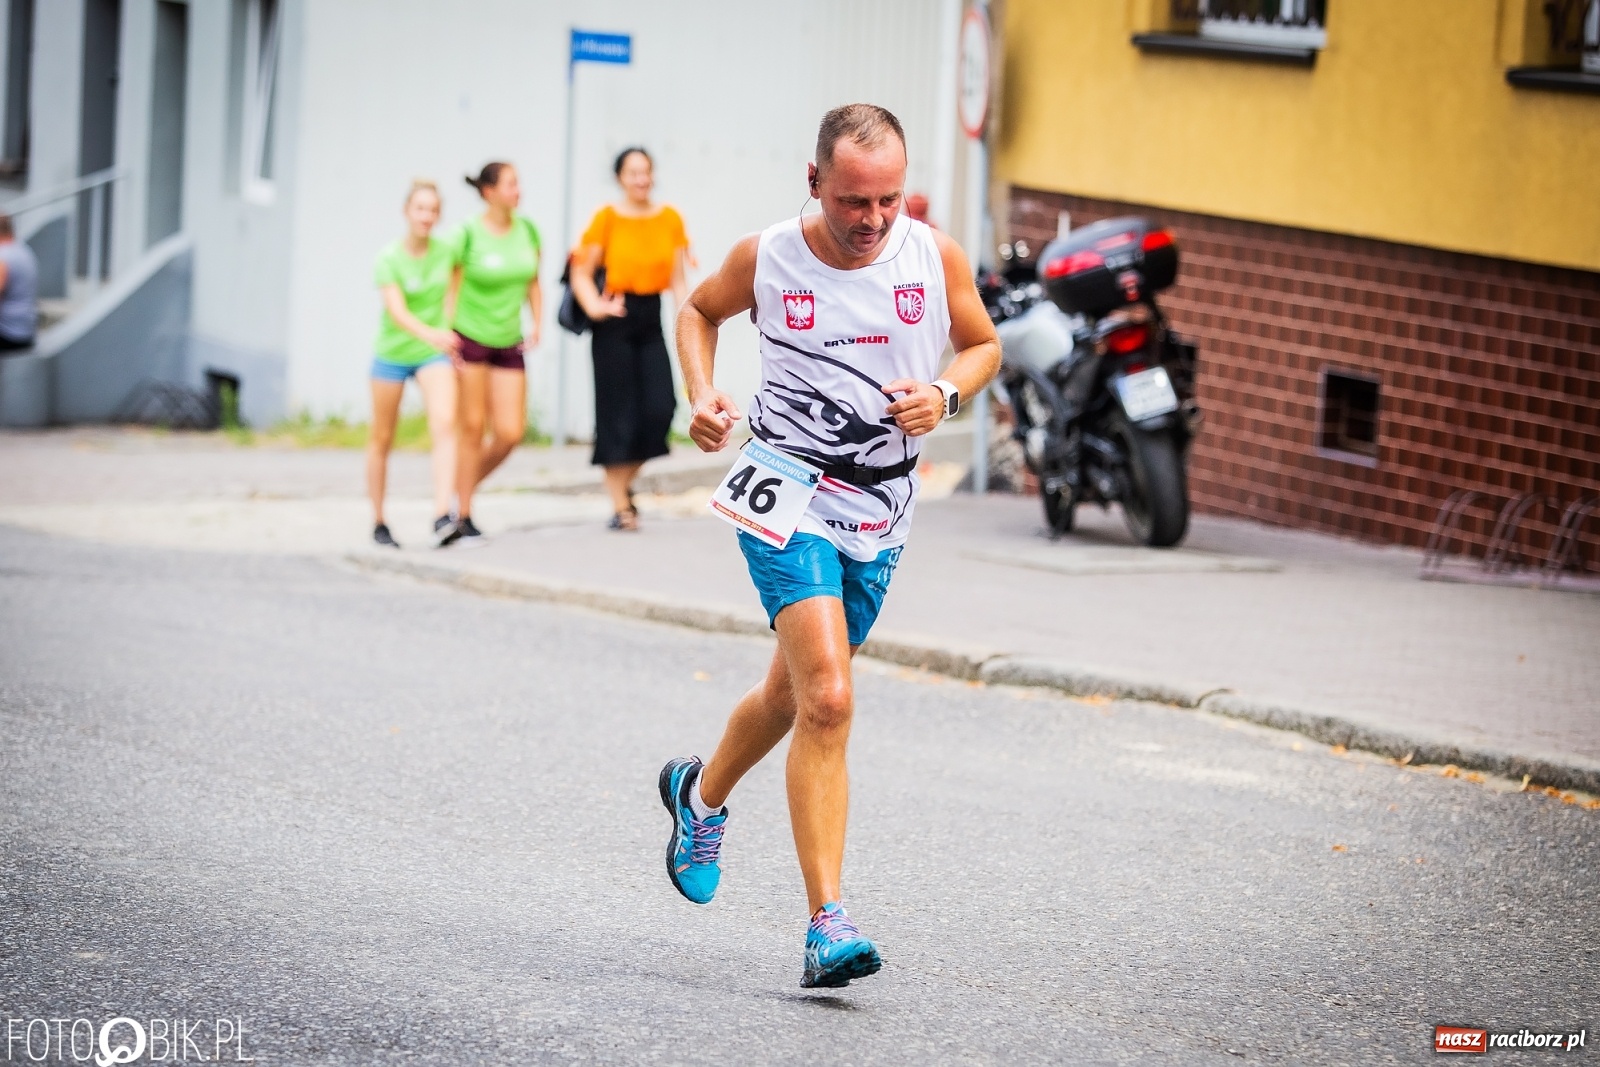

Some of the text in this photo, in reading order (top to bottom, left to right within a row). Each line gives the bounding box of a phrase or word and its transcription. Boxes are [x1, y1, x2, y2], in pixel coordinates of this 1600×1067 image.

[753, 449, 812, 483] KRZANOWICK
[726, 464, 783, 515] 46
[823, 519, 889, 533] AZYRUN
